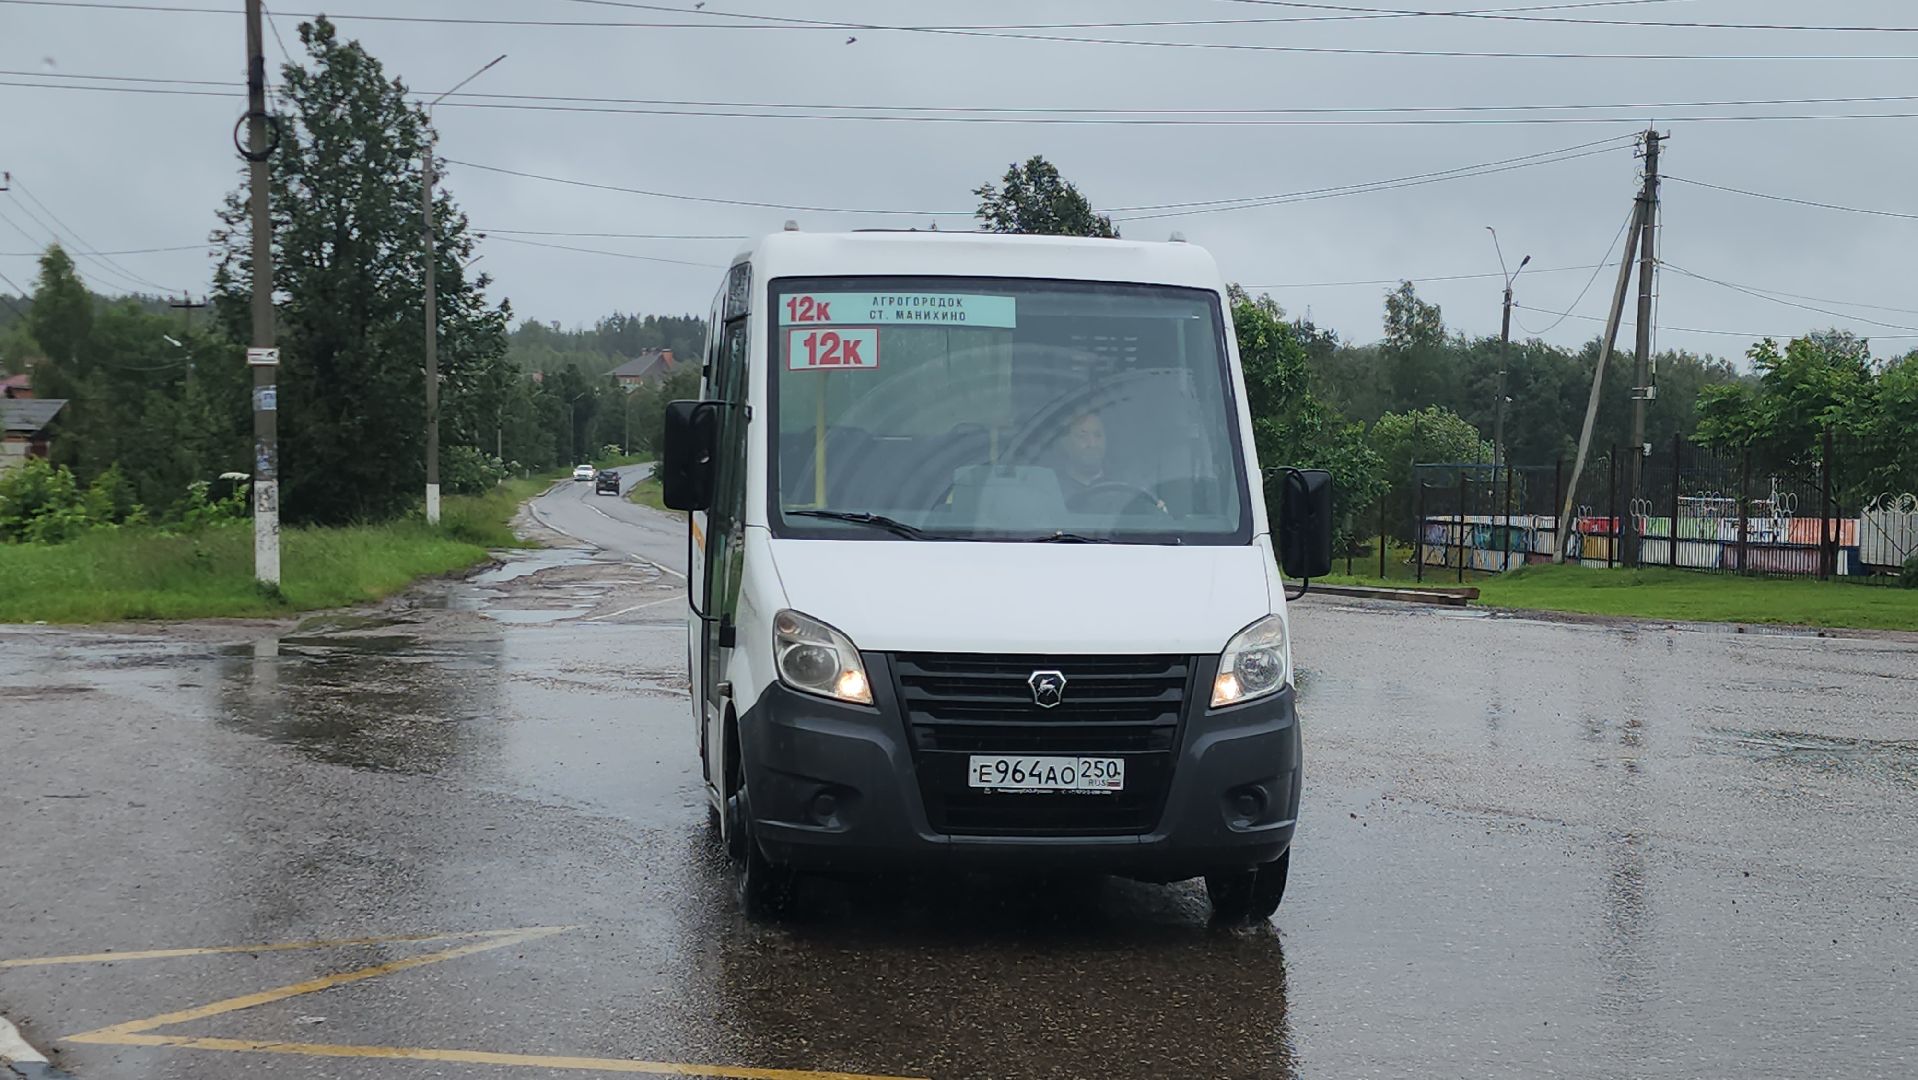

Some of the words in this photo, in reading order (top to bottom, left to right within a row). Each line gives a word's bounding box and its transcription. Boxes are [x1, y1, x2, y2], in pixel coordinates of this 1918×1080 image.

[872, 296, 964, 307] АГРОГОРОДОК
[869, 310, 889, 320] СТ.
[896, 311, 966, 321] МАНИХИНО
[1080, 760, 1118, 778] 250
[1088, 779, 1106, 787] RUS
